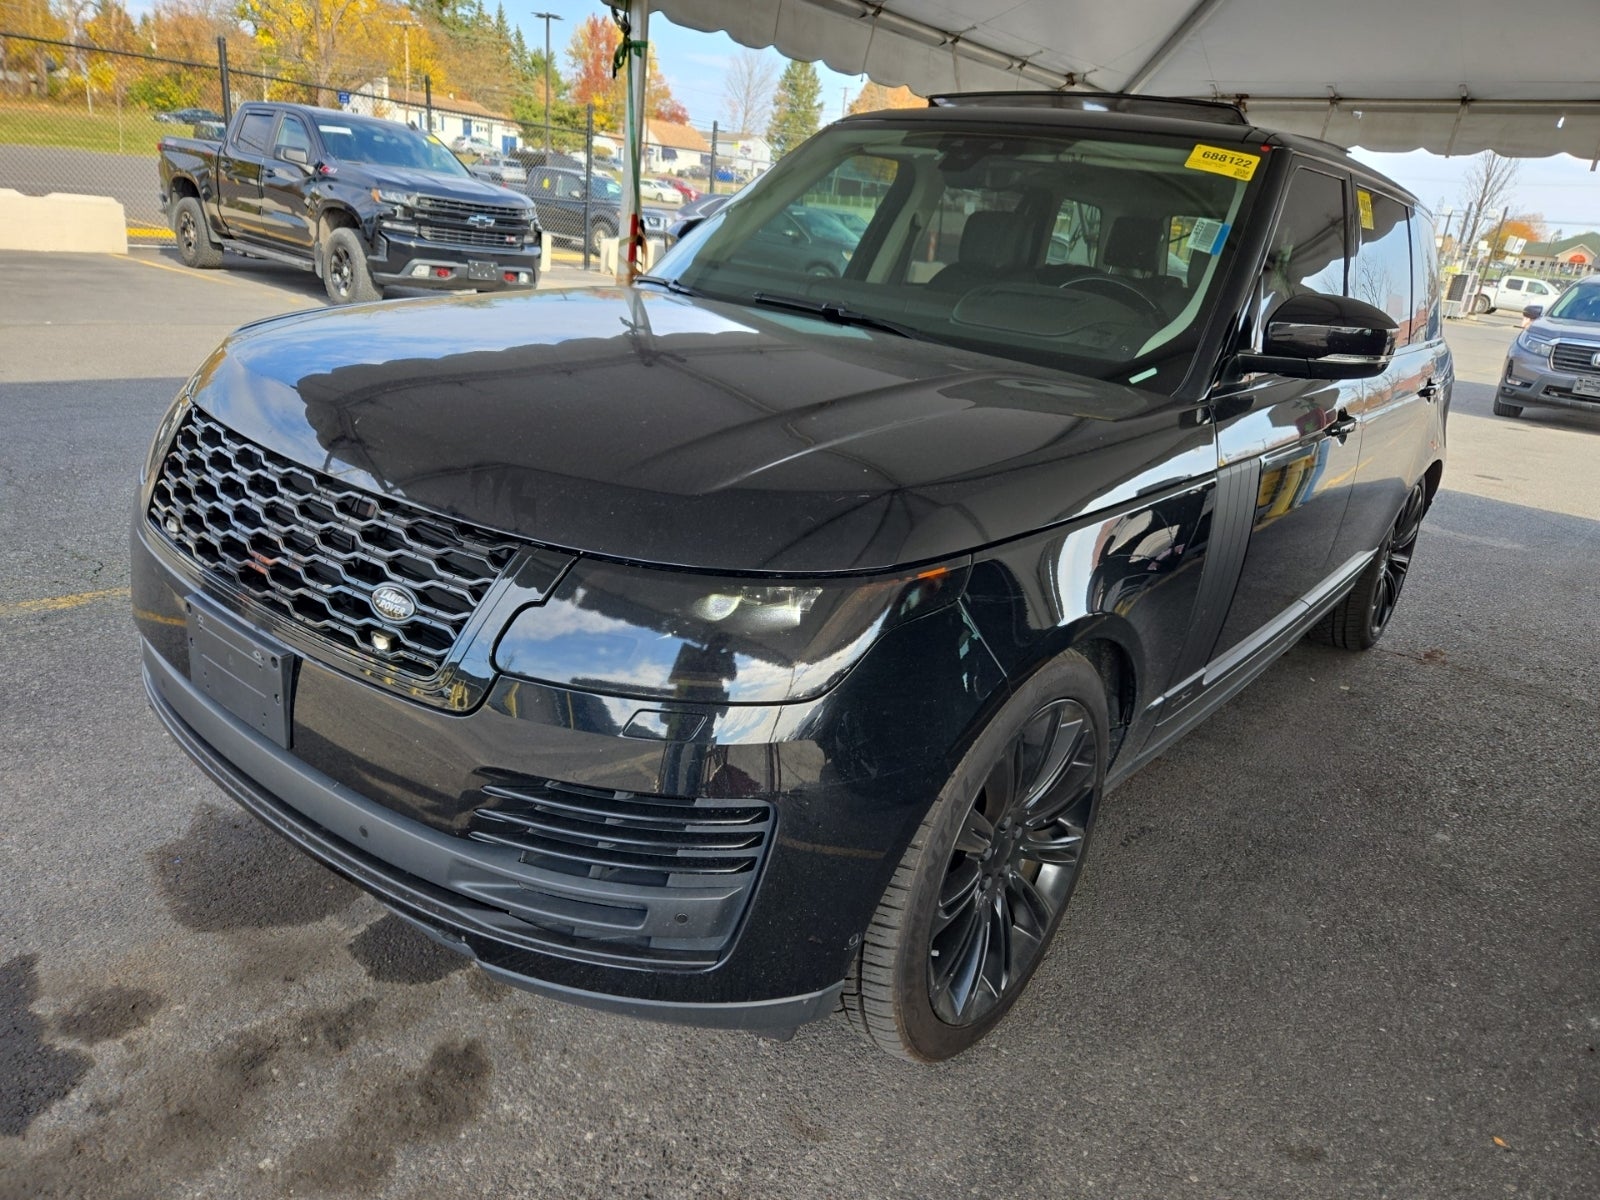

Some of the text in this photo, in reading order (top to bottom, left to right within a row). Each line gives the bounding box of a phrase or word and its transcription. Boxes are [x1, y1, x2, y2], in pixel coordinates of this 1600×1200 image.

[1202, 150, 1252, 168] 688122
[380, 590, 403, 604] LAND
[378, 599, 406, 617] ROVER
